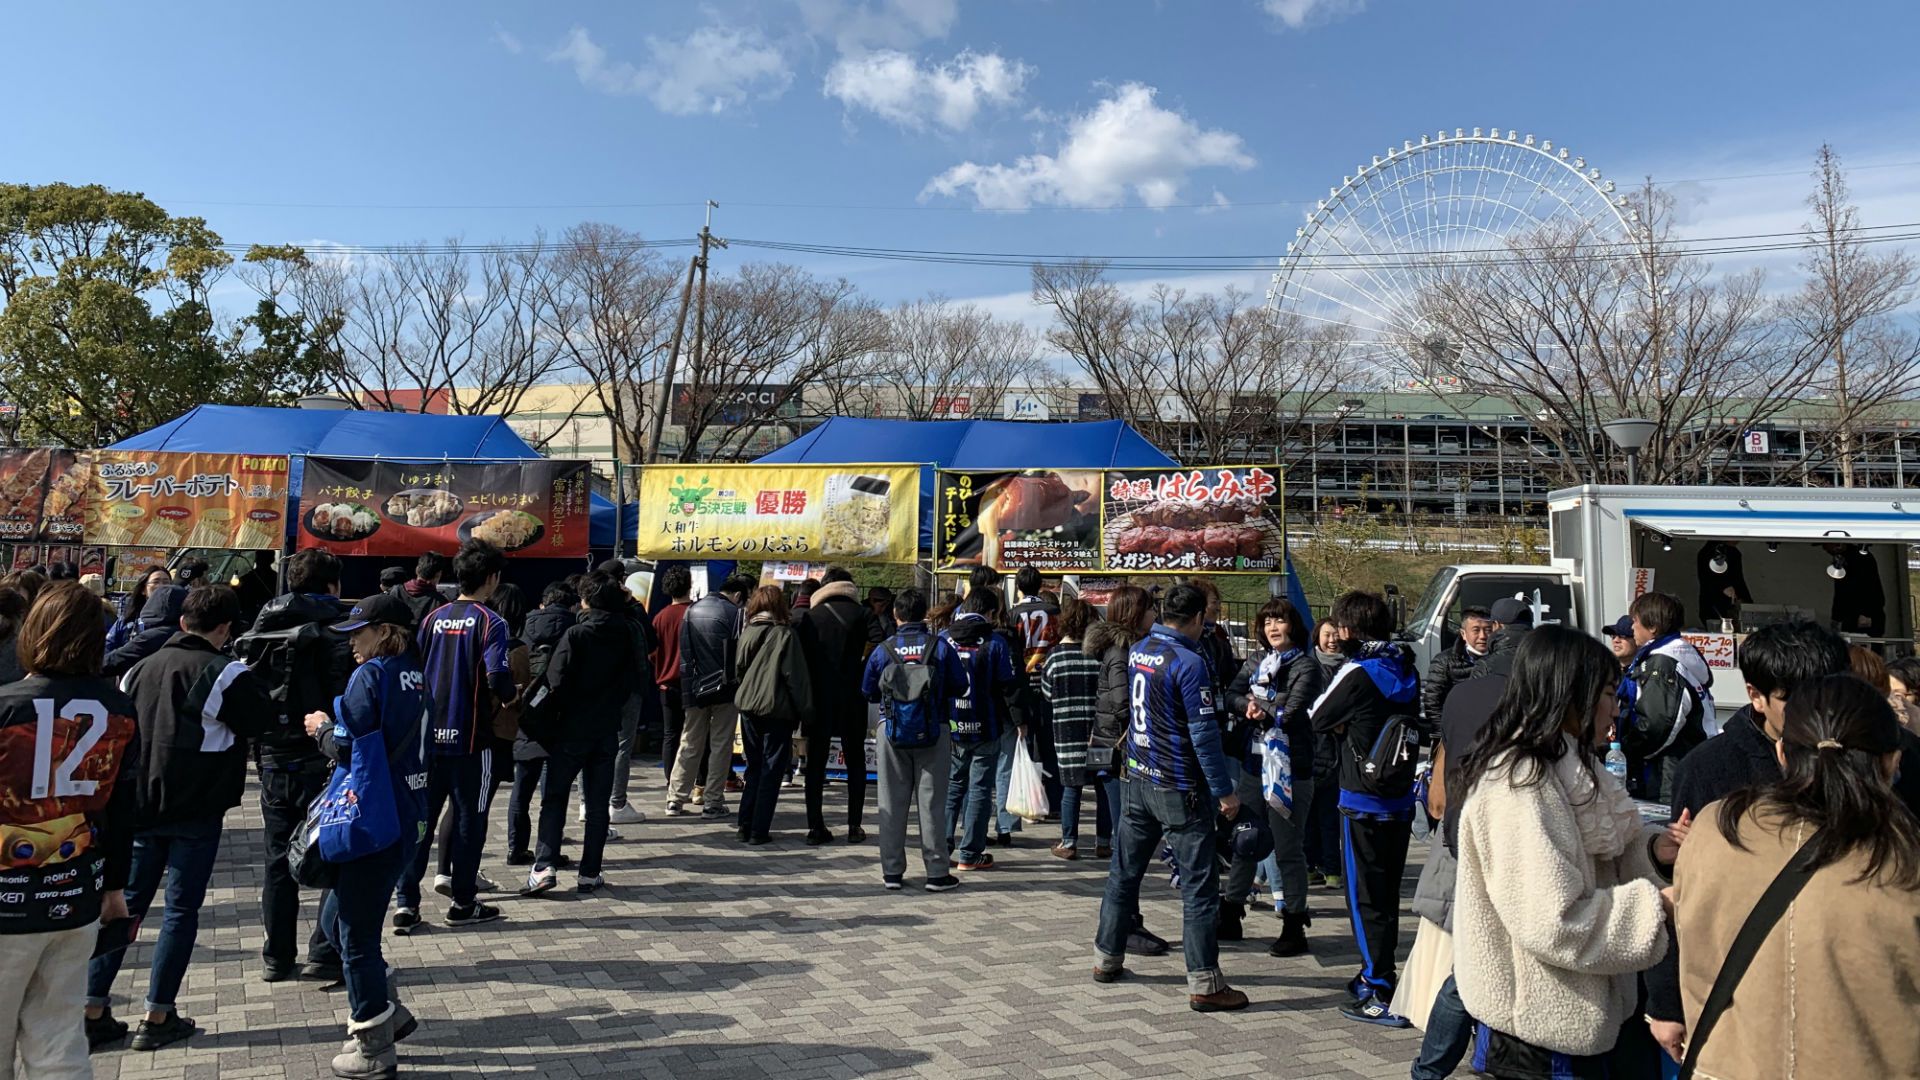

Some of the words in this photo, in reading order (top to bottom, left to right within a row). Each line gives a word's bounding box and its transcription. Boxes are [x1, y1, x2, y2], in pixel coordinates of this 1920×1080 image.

[1751, 432, 1762, 446] B
[242, 457, 287, 472] POTATO
[105, 475, 238, 500] フレーバーポテト
[399, 472, 457, 486] しゅうまい
[1110, 478, 1152, 501] 特選
[1156, 467, 1278, 502] はらみ串
[317, 485, 374, 500] パオ餃子
[468, 493, 541, 506] エビしゅうまい
[754, 489, 808, 515] 優勝
[660, 520, 699, 534] 大和牛
[943, 486, 958, 568] チーズドック
[671, 535, 810, 553] ホルモンの天ぷら
[786, 563, 805, 577] 500
[1107, 552, 1197, 571] メガジャンボ
[1199, 555, 1234, 568] サイズ
[1236, 556, 1274, 569] 0cm!!
[432, 616, 476, 635] ROHTO
[1020, 609, 1050, 649] 12
[894, 643, 927, 656] OHT
[1128, 651, 1165, 668] ROHTO
[399, 670, 423, 691] ROH
[1132, 672, 1147, 733] 8
[957, 721, 982, 731] SHIP
[30, 697, 109, 800] 12
[43, 868, 78, 885] ROHTO
[35, 891, 59, 900] TOYO
[60, 887, 84, 898] TIRES
